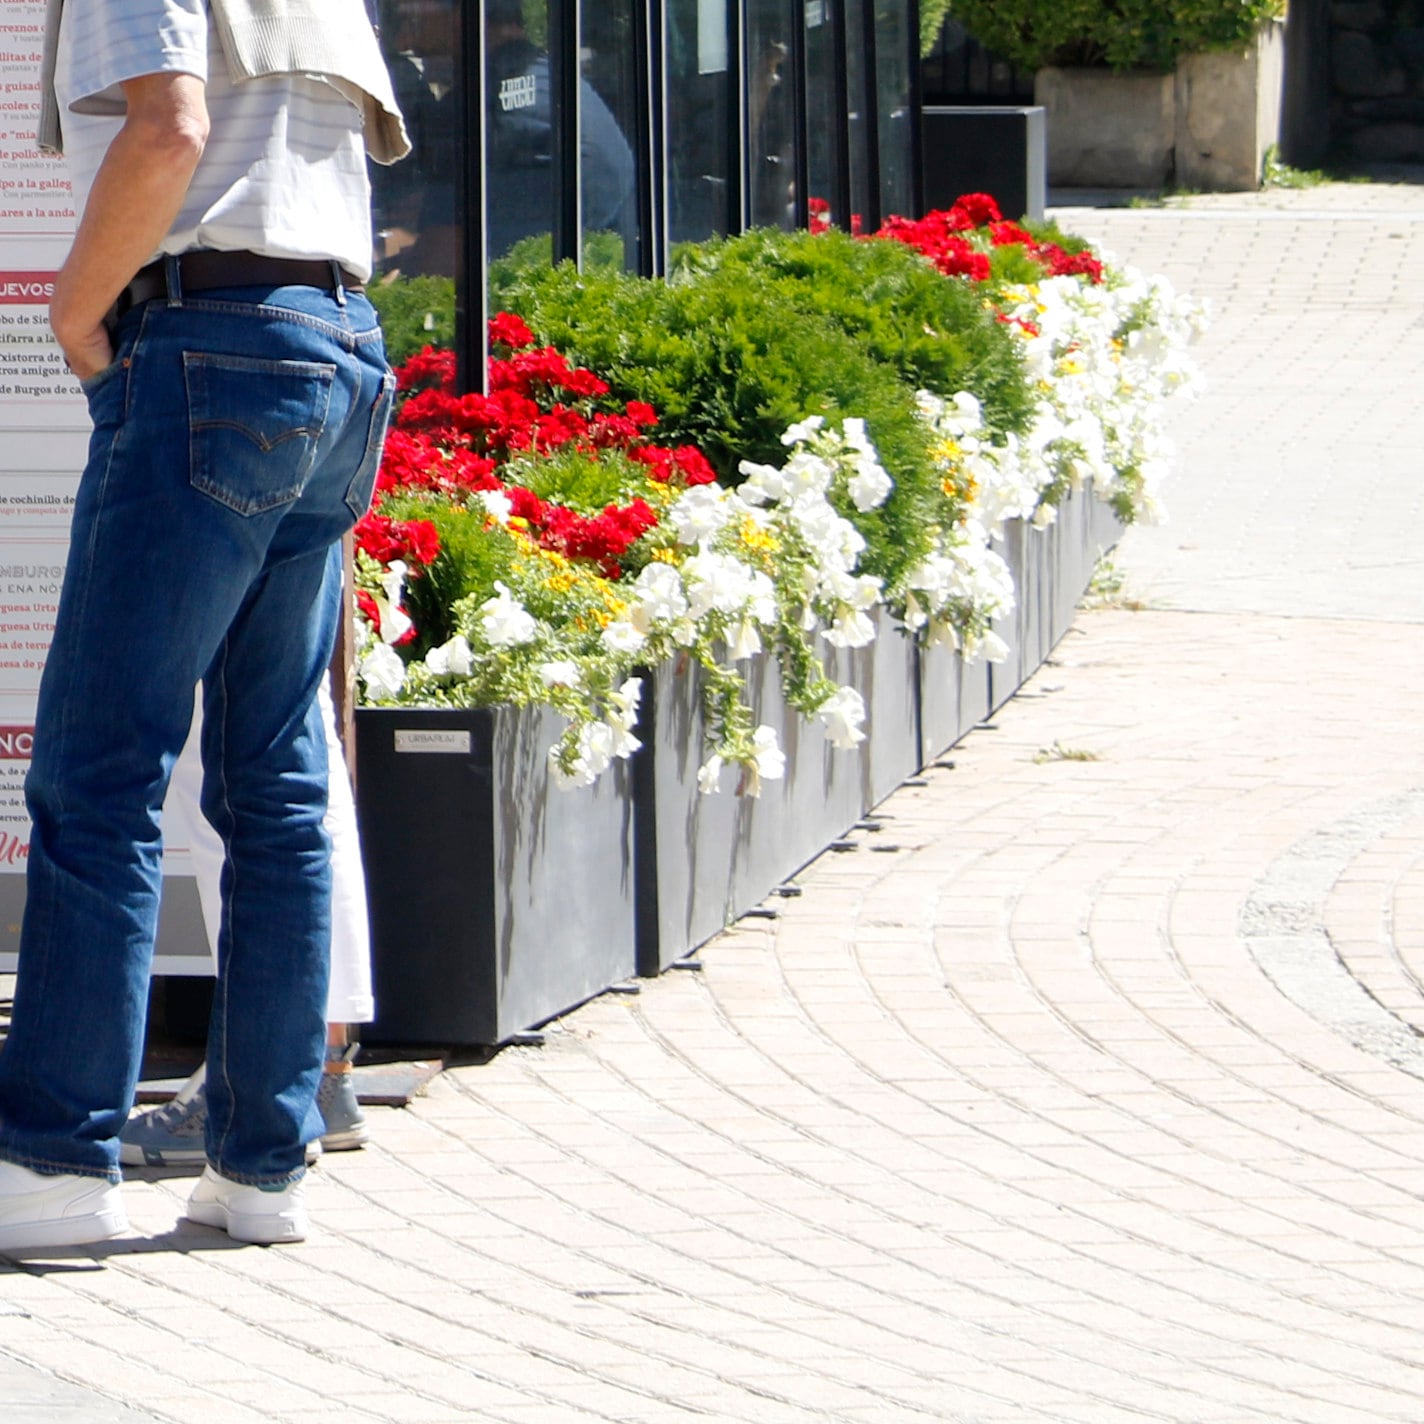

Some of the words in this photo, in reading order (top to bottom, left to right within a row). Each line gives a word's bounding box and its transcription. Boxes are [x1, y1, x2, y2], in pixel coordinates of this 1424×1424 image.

[29, 53, 42, 62] de
[5, 81, 41, 93] guisad
[27, 179, 36, 188] la
[39, 179, 72, 190] galleg
[27, 210, 33, 218] a
[36, 208, 46, 218] la
[17, 315, 30, 324] de
[0, 384, 12, 394] de
[14, 384, 51, 396] Burgos
[54, 384, 67, 394] de
[8, 585, 34, 593] ENA
